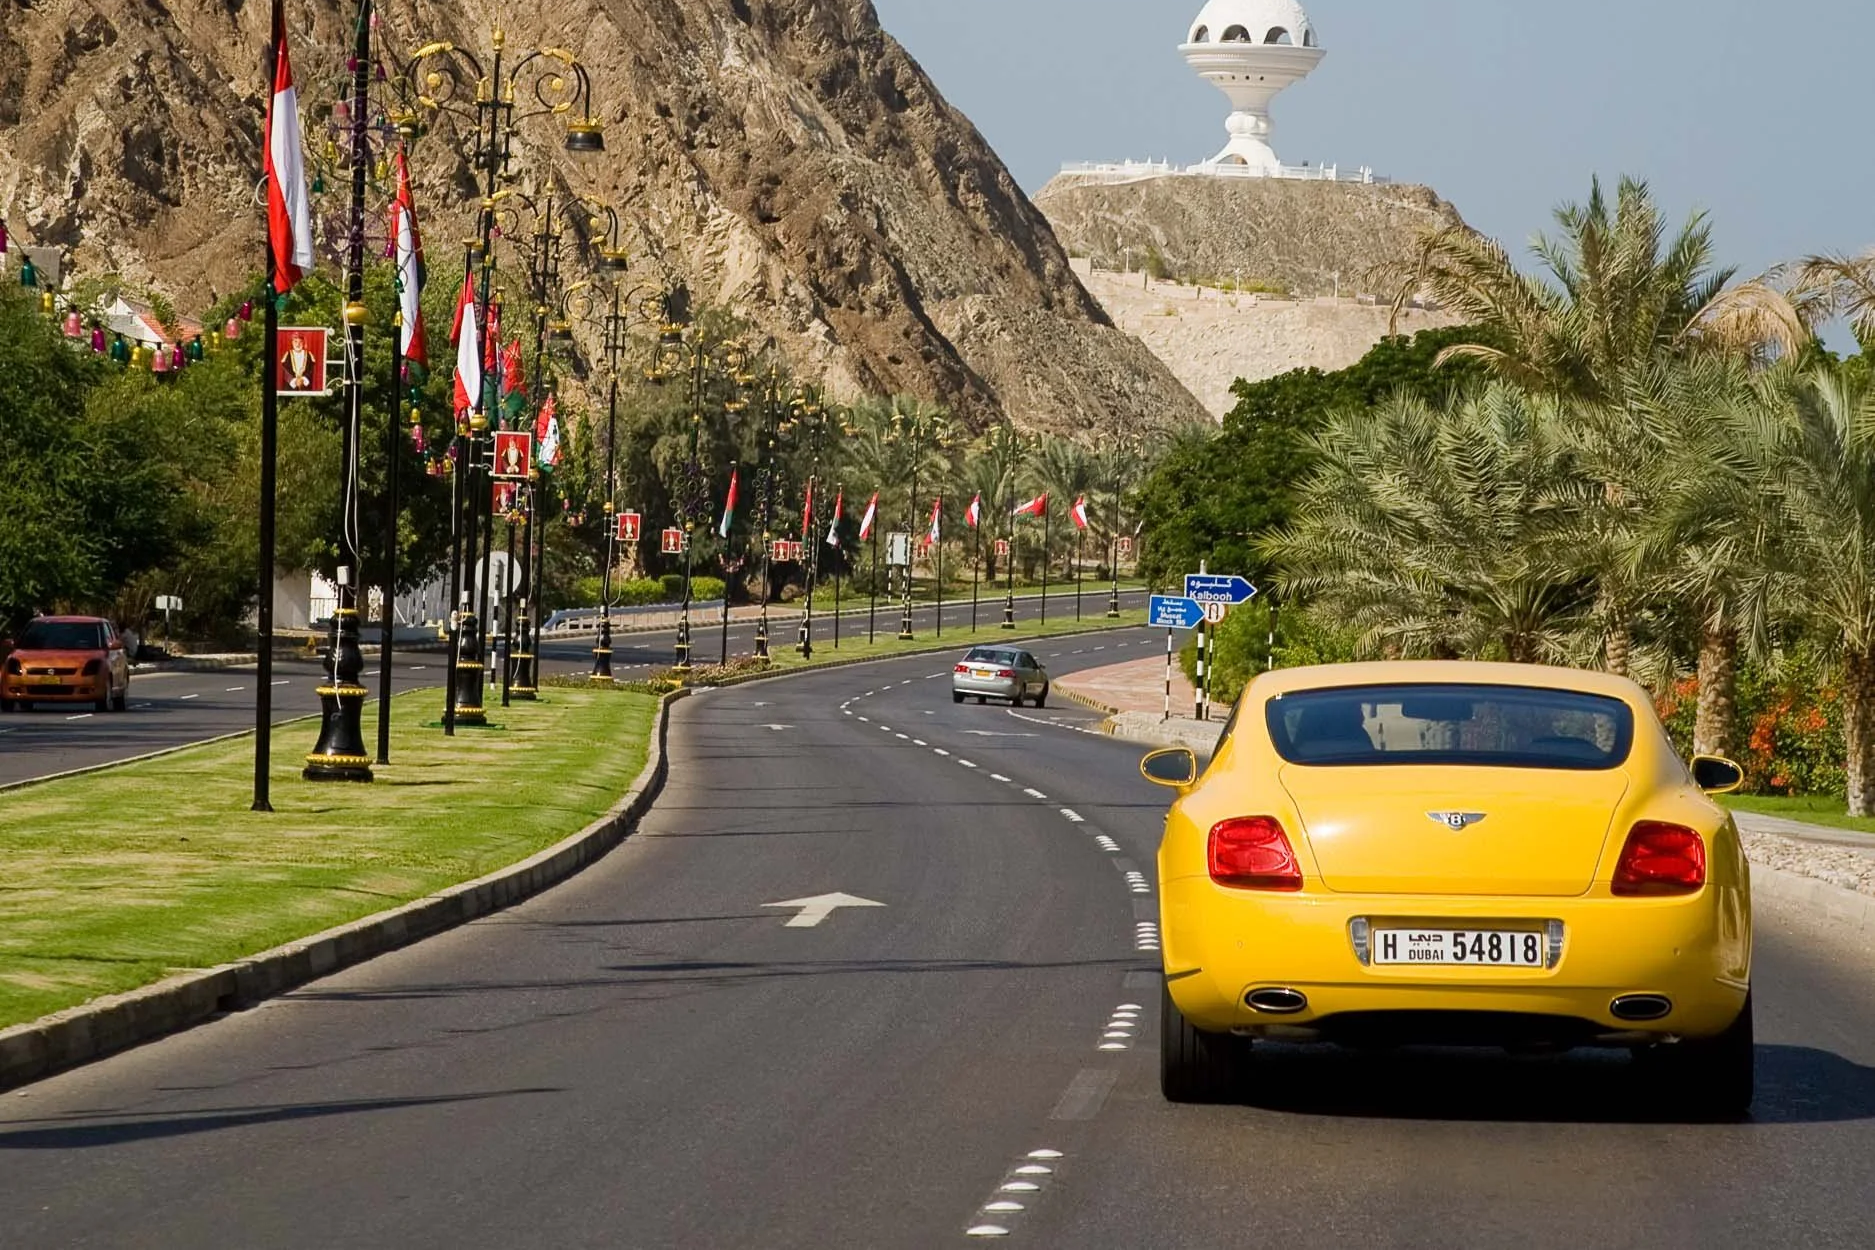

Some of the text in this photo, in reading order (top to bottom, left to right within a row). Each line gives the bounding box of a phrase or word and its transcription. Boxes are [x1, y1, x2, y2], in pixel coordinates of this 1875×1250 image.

[1189, 590, 1232, 601] Kalbooh
[1408, 934, 1443, 946] دبي
[1383, 933, 1397, 960] H
[1452, 932, 1538, 963] 54818
[1408, 949, 1444, 961] DUBAI
